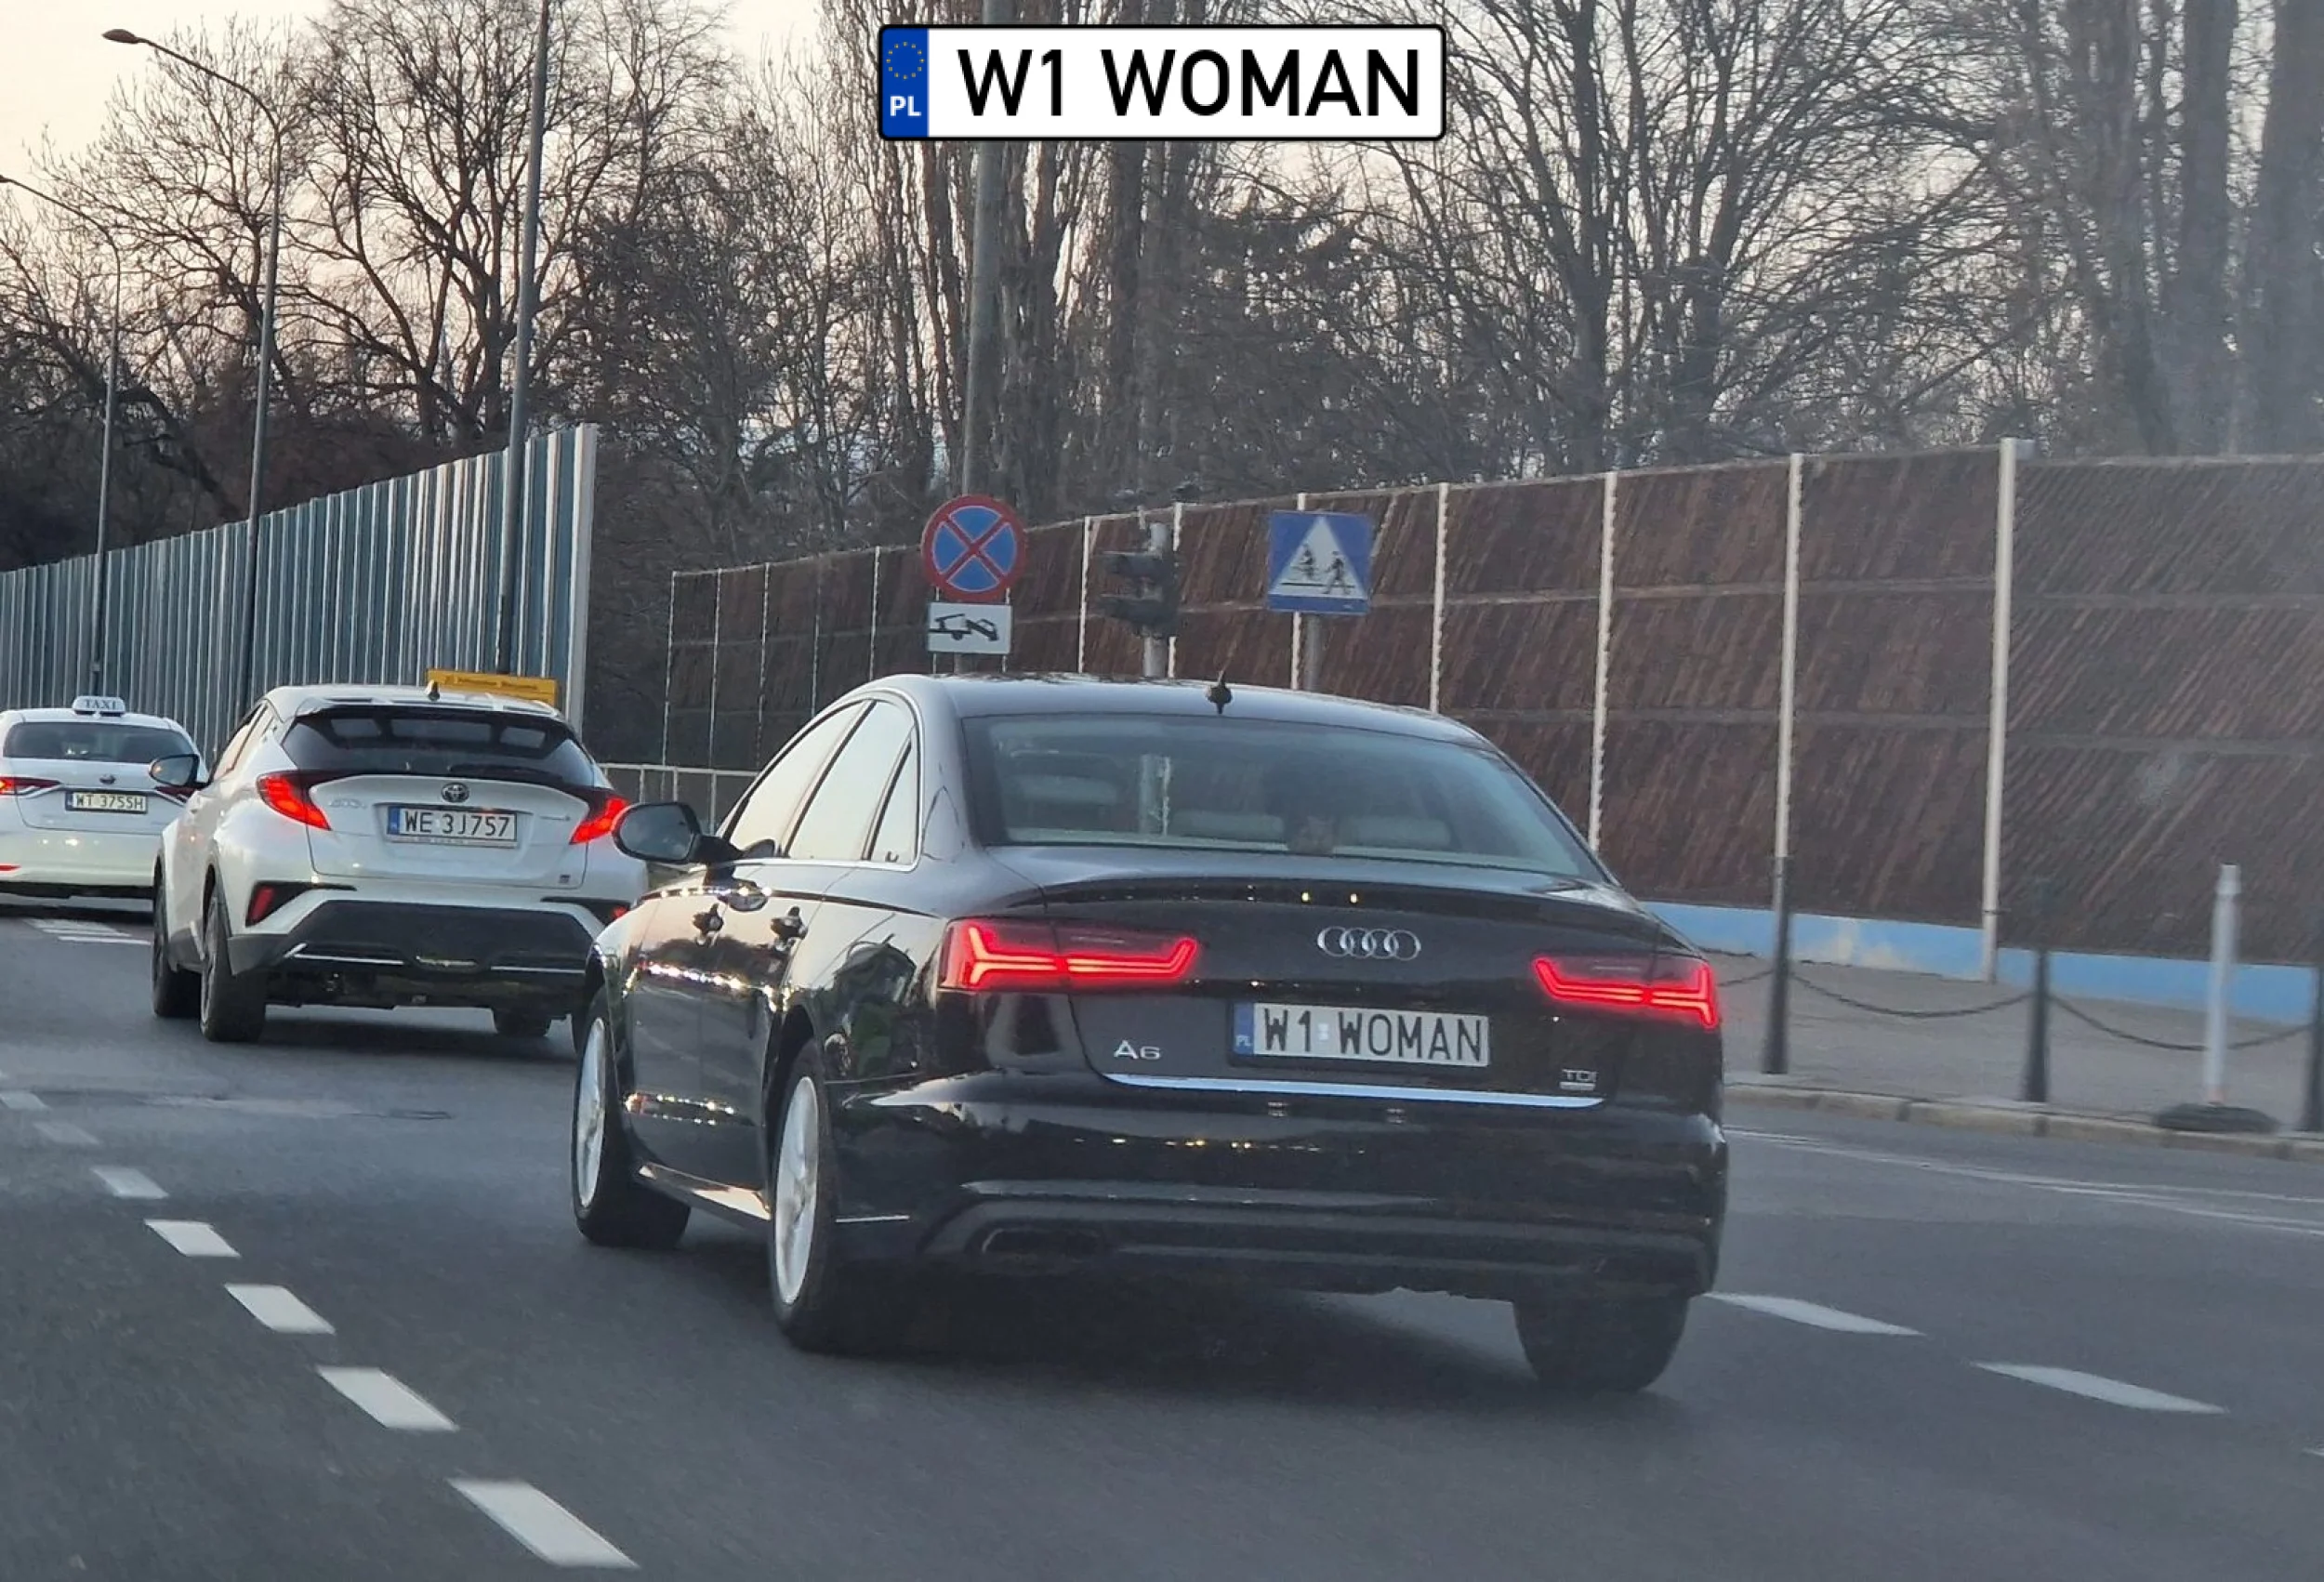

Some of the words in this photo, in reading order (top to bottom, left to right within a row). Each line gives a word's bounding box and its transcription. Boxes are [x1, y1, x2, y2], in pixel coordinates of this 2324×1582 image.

[85, 699, 116, 709] TAXI
[76, 794, 94, 808] WT
[404, 811, 433, 834] WE
[442, 813, 510, 837] 3J757
[1235, 1035, 1251, 1047] PL
[1263, 1008, 1312, 1052] W1
[1338, 1010, 1482, 1062] WOMAN
[1114, 1039, 1161, 1061] A6
